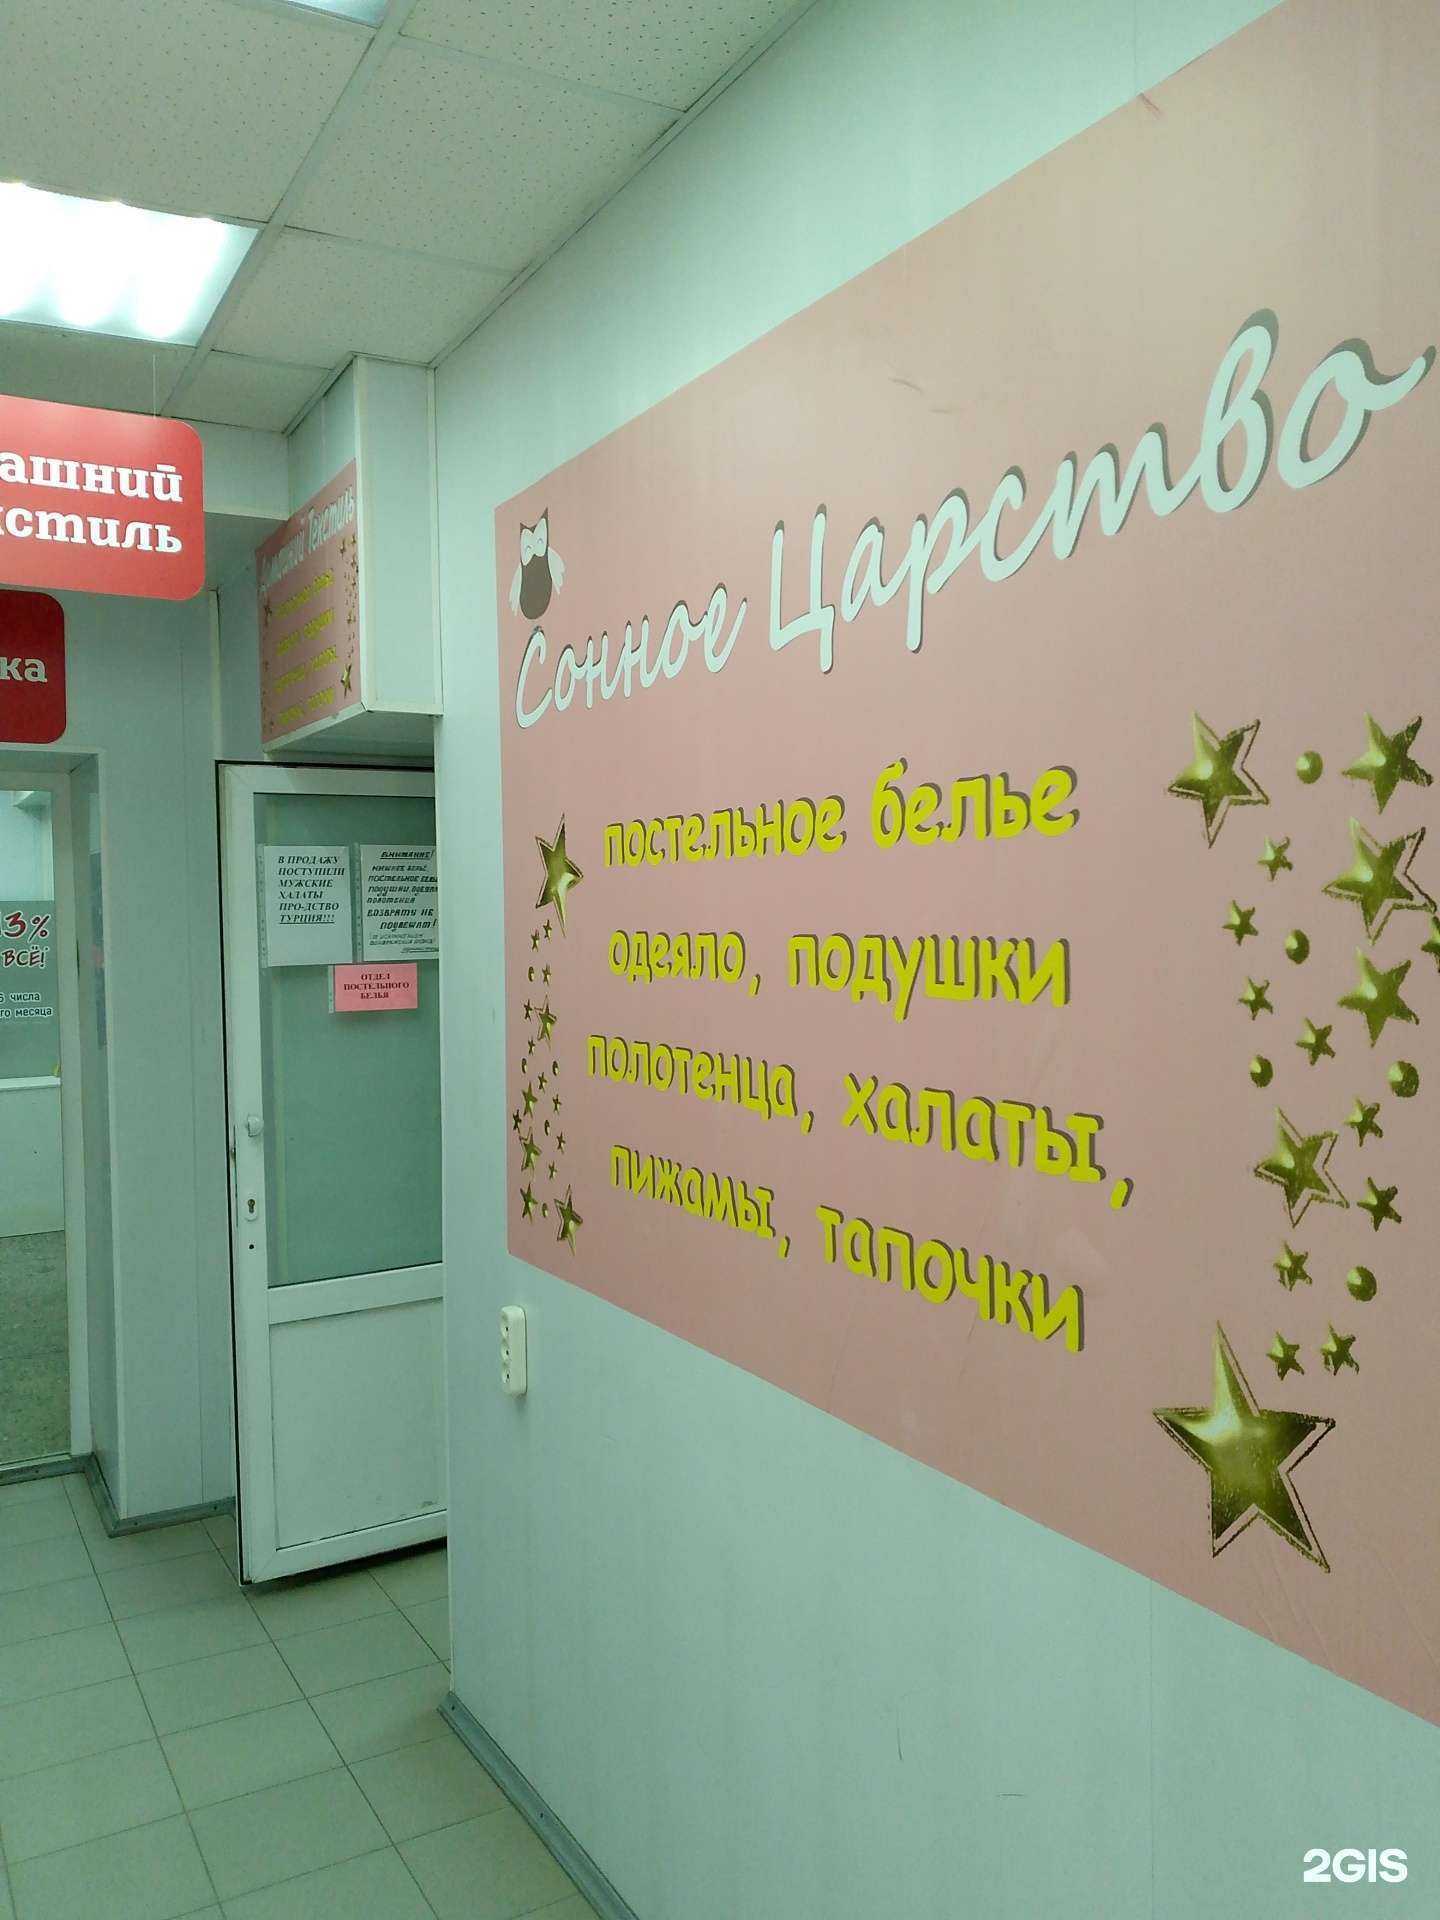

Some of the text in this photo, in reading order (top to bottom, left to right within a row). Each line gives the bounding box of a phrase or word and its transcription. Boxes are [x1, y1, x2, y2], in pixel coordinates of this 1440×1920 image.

[514, 309, 1438, 729] Сонное Царство
[0, 504, 184, 554] стиль
[604, 757, 1081, 868] постельное белье
[278, 855, 339, 865] В ПРОДАЖУ
[278, 867, 345, 876] ПОСТУПИЛИ
[278, 879, 333, 888] МУЖСКИЕ
[278, 891, 323, 900] ХАЛАТЫ
[279, 902, 340, 912] ПРО-ДСТВО
[280, 914, 335, 923] ТУРЦИЯ!!!
[360, 973, 391, 981] ОТДЕЛ
[608, 930, 1071, 1022] одеяло, подушки
[344, 982, 410, 991] ПОСТЕЛЬНОГО
[10, 992, 41, 1002] числа
[15, 1007, 53, 1018] месяца
[586, 1035, 1134, 1210] полотенца, халаты,
[610, 1145, 1086, 1353] пижамы, тапочки
